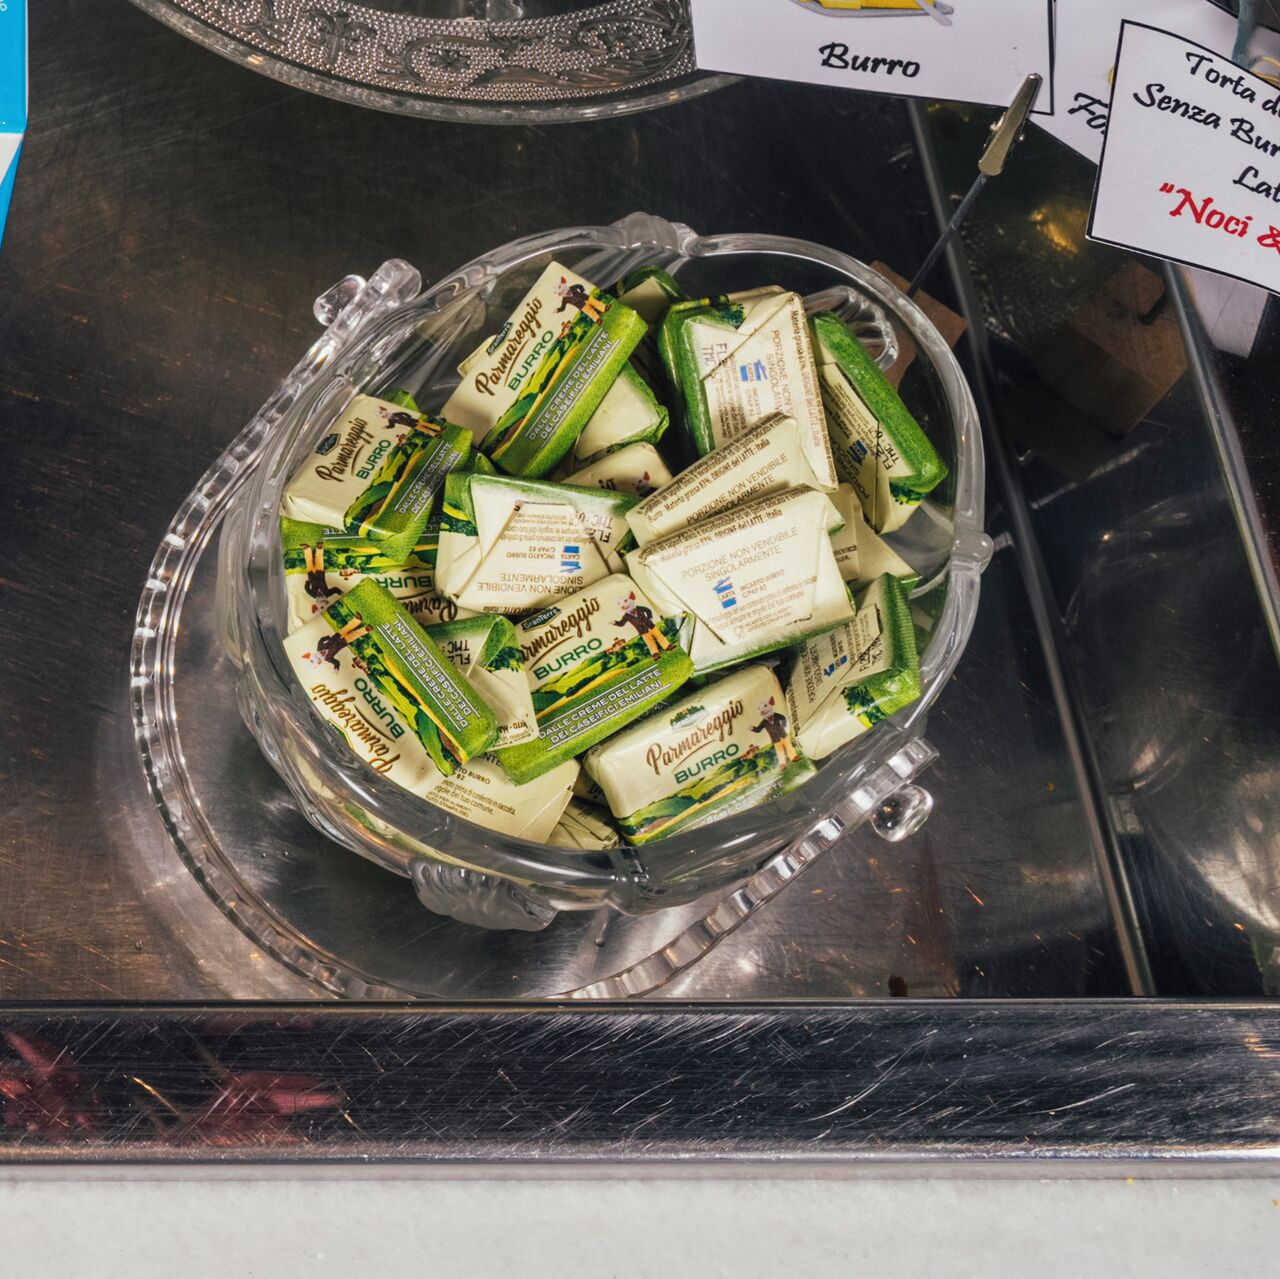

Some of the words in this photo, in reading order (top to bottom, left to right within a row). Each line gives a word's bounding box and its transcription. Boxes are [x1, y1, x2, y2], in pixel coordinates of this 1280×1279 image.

[818, 41, 922, 80] Burro
[1186, 52, 1256, 104] Torta
[1133, 83, 1221, 130] Senza
[474, 296, 543, 397] Parmareggio
[507, 329, 555, 392] BURRO
[315, 417, 369, 482] Parmareggio
[355, 438, 392, 480] BURRO
[532, 637, 603, 679] BURRO
[353, 677, 405, 739] BURRO
[645, 699, 745, 776] Parmareggio
[674, 743, 740, 784] BURRO
